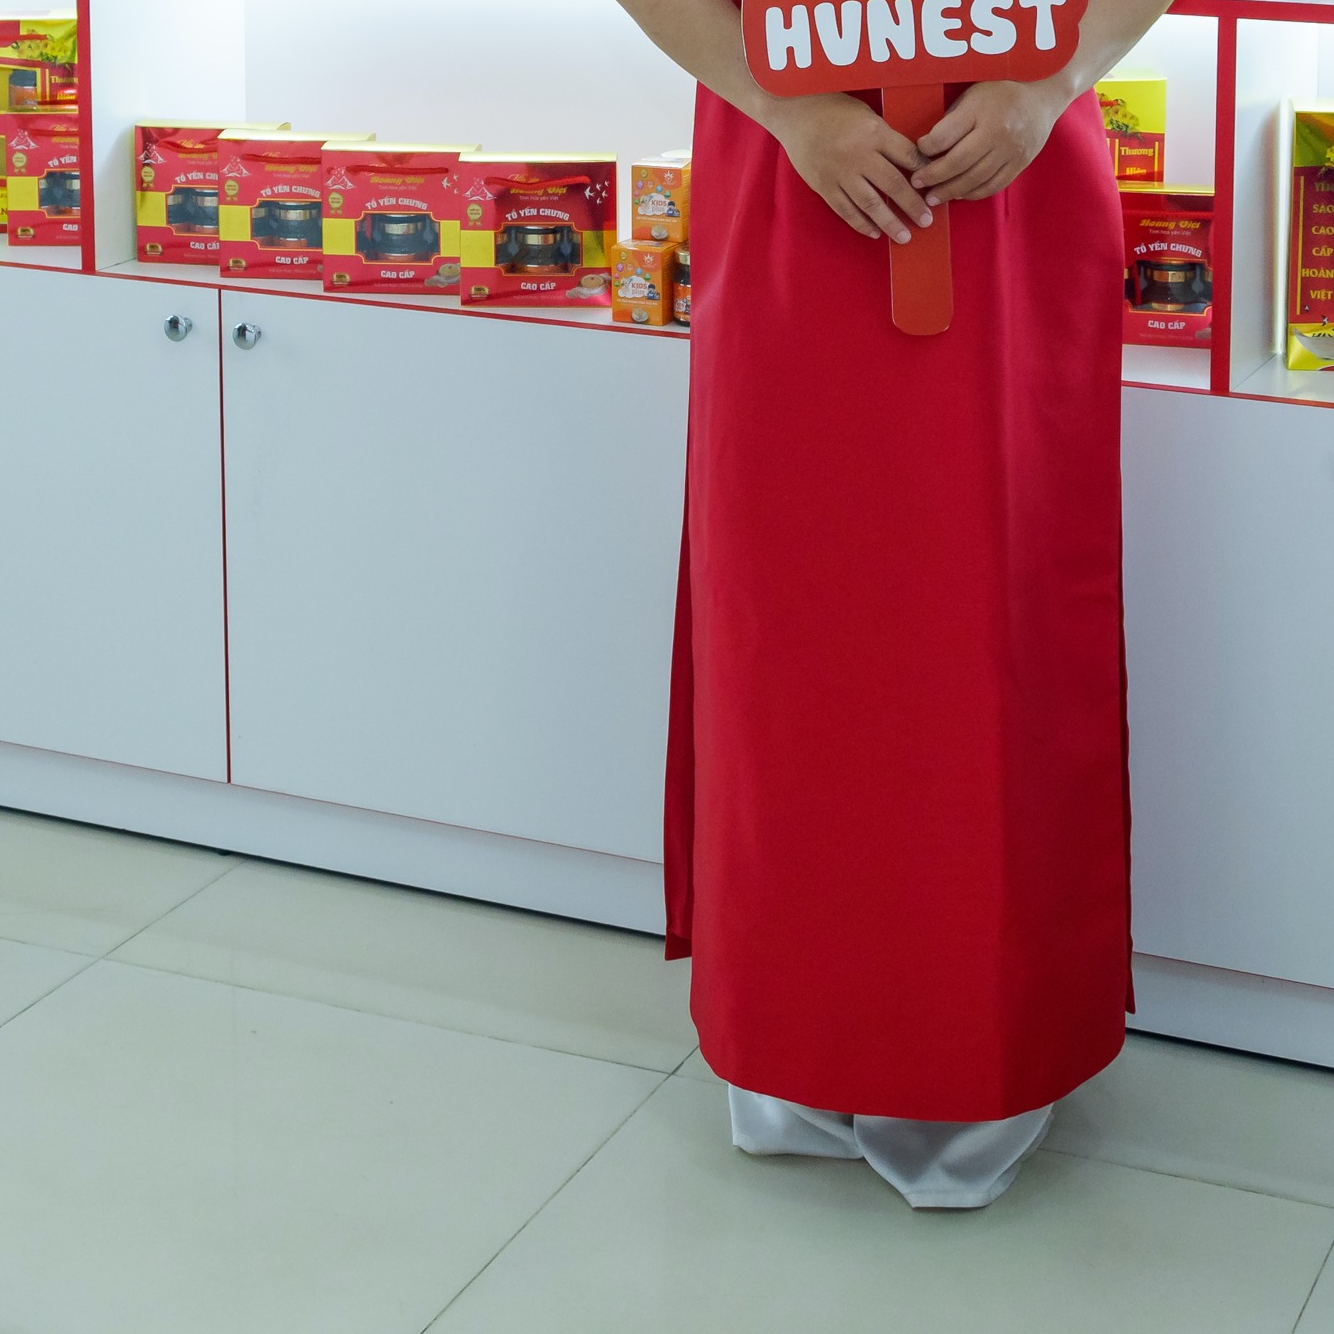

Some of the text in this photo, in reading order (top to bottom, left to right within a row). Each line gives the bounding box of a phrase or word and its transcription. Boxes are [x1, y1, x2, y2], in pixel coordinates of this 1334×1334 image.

[651, 199, 667, 207] KIDS
[1170, 242, 1202, 258] CHƯNG
[521, 281, 556, 291] CAO CẤP
[630, 282, 648, 290] KIDS
[1147, 320, 1185, 330] CAO CẤP
